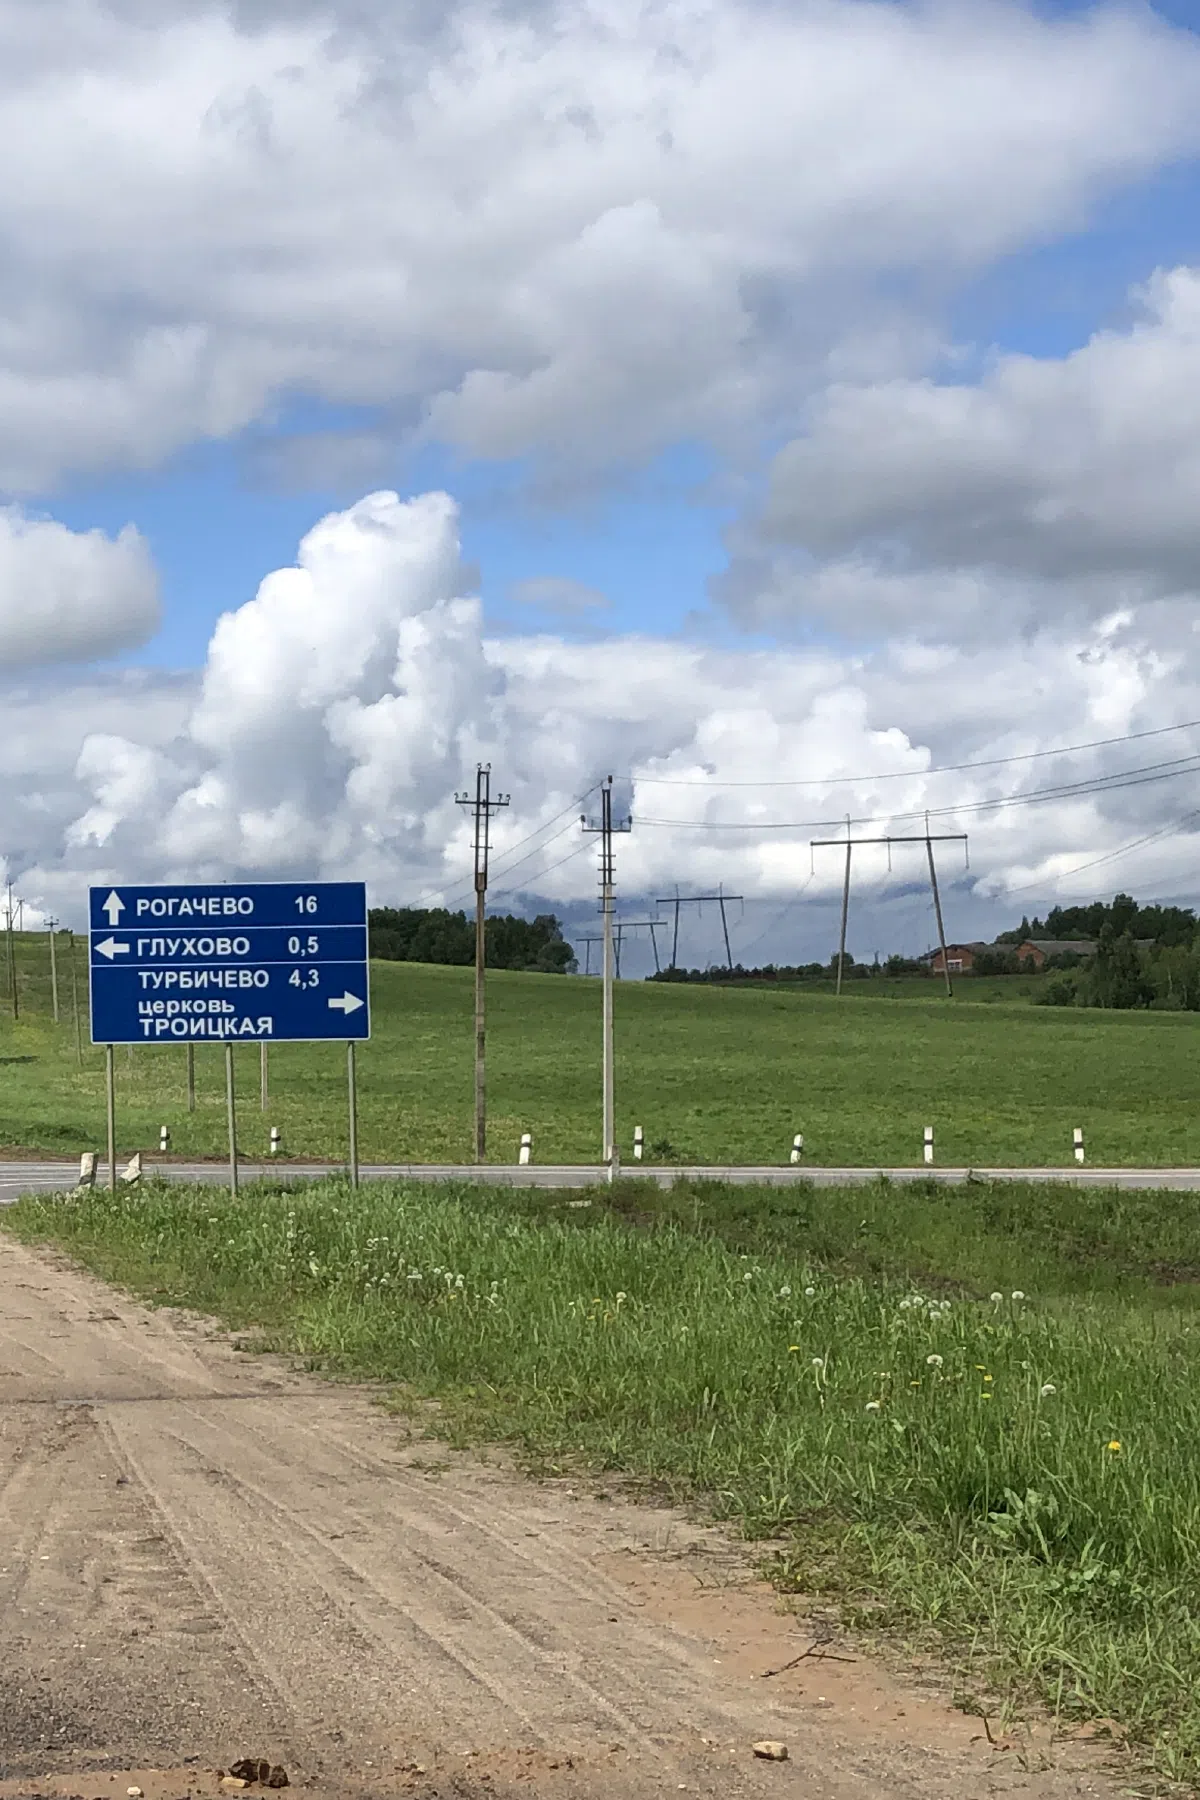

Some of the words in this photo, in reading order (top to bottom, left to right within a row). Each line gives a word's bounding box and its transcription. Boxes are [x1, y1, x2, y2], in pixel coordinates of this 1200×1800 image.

[136, 896, 254, 917] РОГАЧЕВО
[295, 895, 318, 914] 16
[137, 936, 250, 957] ГЛУХОВО
[288, 936, 319, 957] 0,5
[138, 969, 269, 989] ТУРБИЧЕВО
[288, 969, 320, 990] 4,3
[138, 999, 236, 1017] церковь
[138, 1016, 274, 1038] ТРОИЦКАЯ
